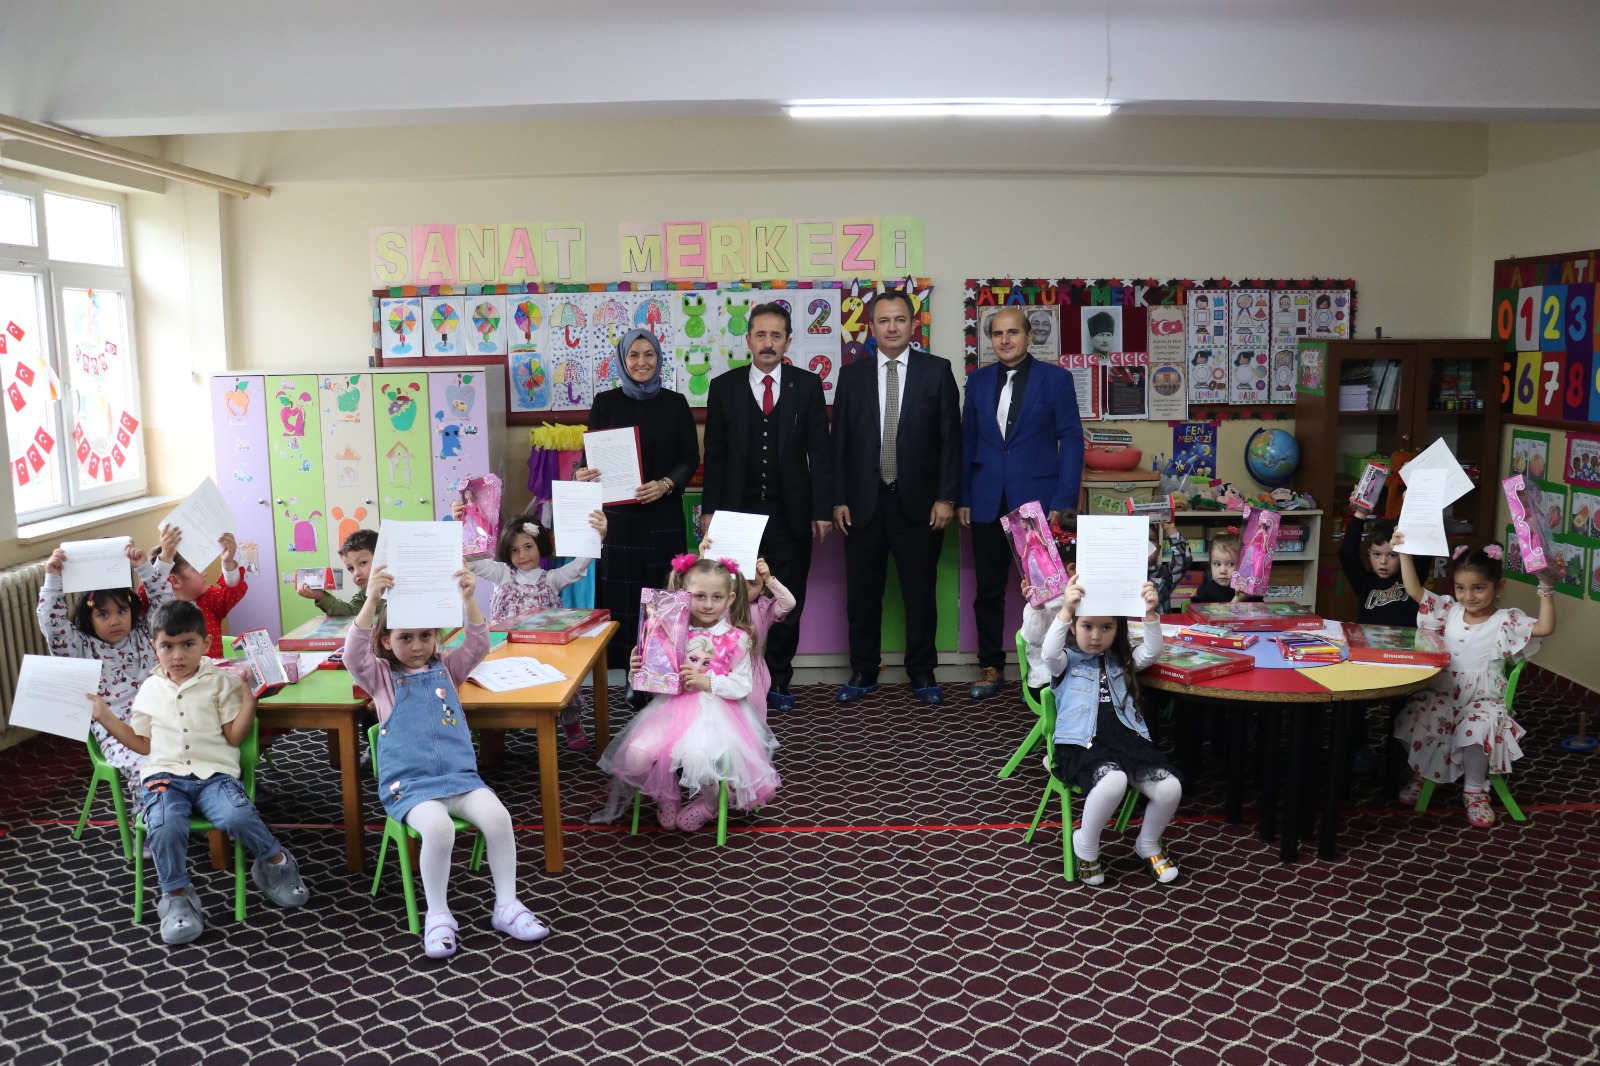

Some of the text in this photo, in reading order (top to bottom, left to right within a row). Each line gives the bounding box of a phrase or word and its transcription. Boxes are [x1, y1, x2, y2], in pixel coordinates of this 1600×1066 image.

[374, 227, 582, 283] SANAT
[808, 299, 831, 334] 2
[1185, 425, 1205, 435] FEN
